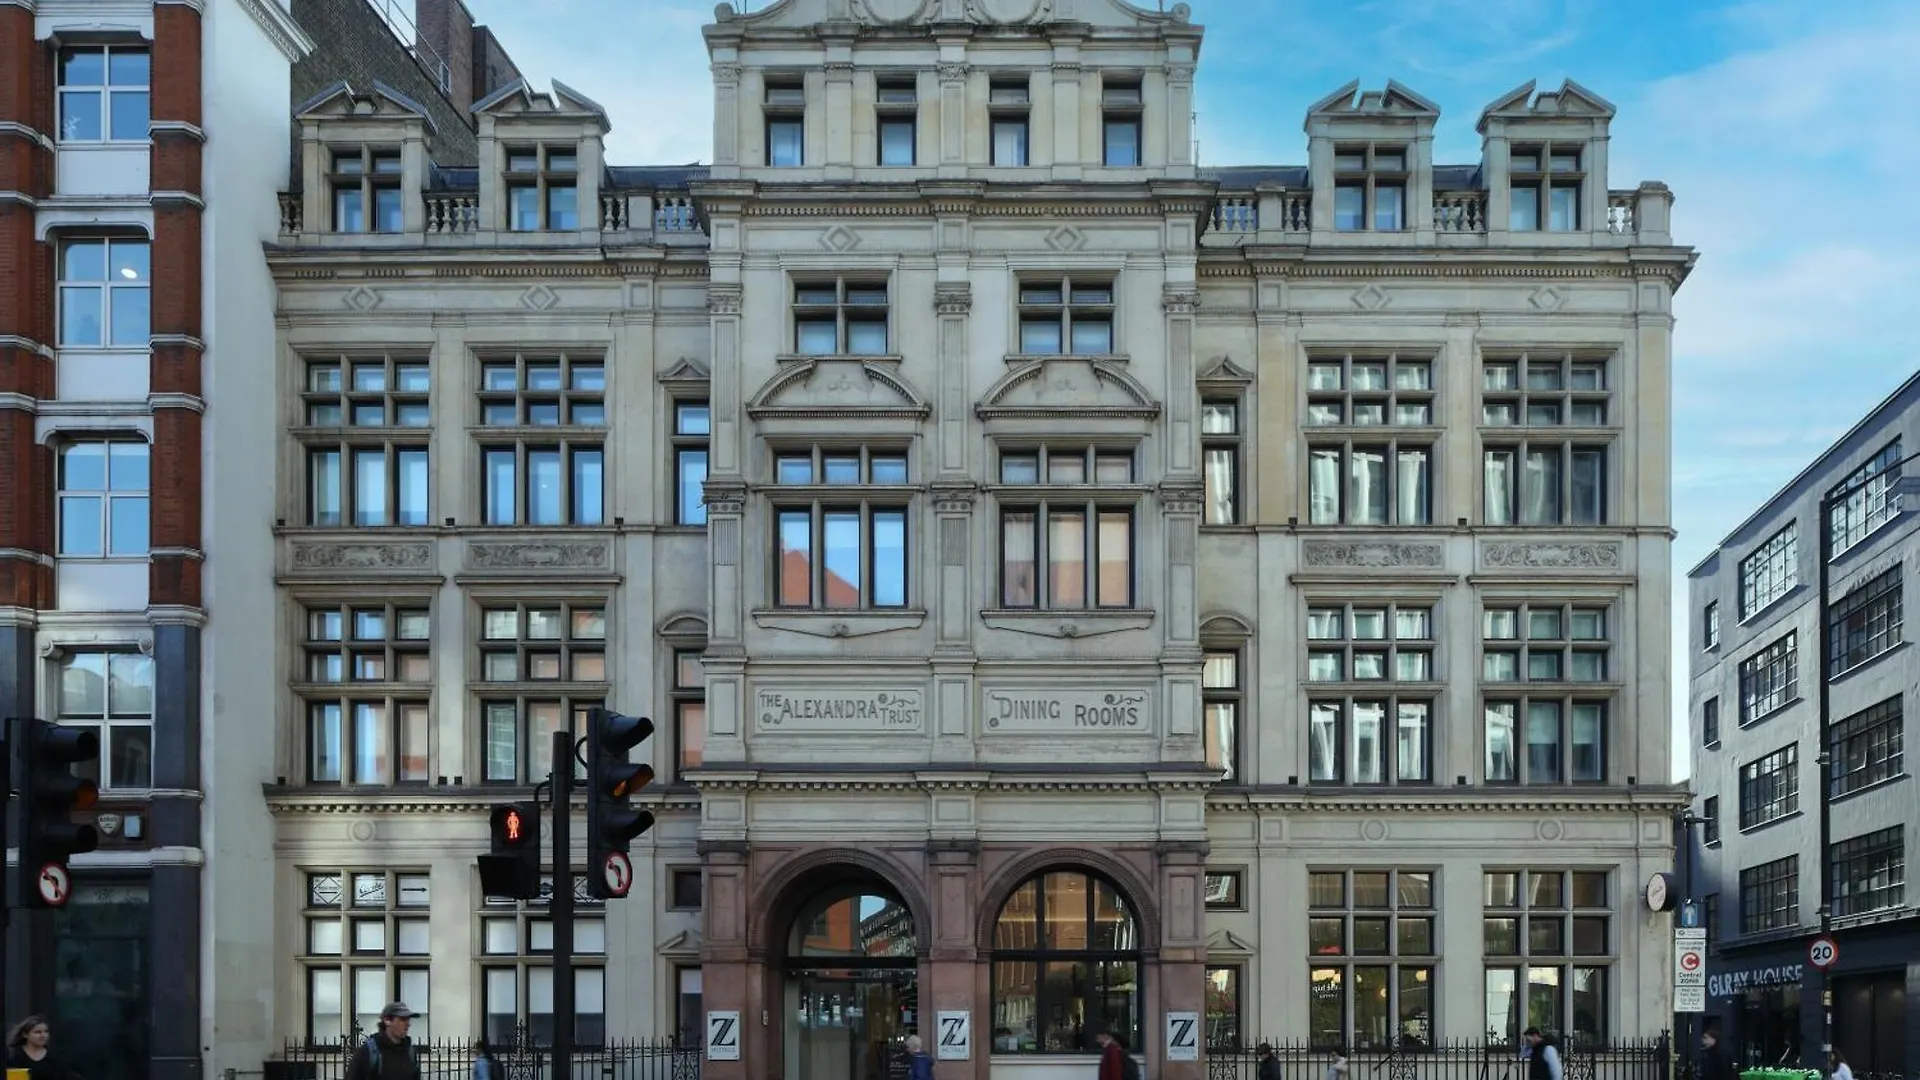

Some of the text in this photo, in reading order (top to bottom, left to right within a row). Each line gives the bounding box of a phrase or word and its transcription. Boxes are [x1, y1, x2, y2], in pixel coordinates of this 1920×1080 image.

[760, 694, 920, 725] THE ALEXANDRA TRUST
[992, 695, 1138, 727] DINING ROOMS
[1812, 946, 1833, 960] 20
[1753, 964, 1803, 988] HOUSE
[711, 1018, 736, 1046] Z
[941, 1018, 966, 1046] Z
[1170, 1019, 1195, 1047] Z
